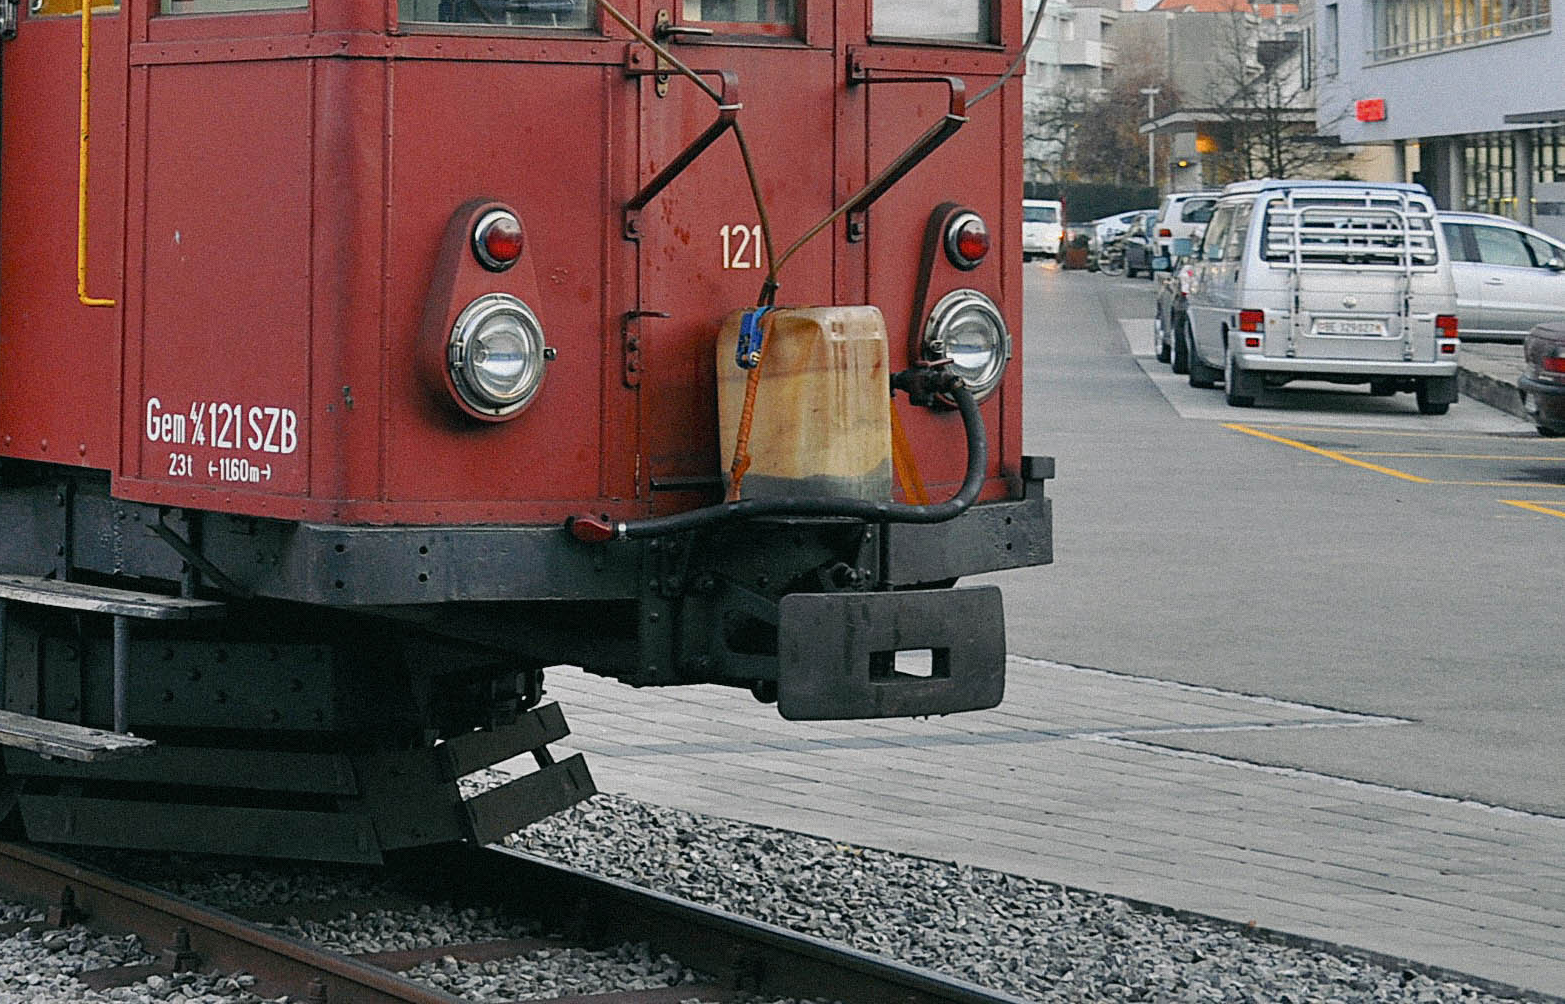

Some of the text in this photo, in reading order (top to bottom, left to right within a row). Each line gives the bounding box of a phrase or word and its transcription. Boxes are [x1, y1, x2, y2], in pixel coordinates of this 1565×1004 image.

[720, 225, 761, 268] 121
[146, 397, 185, 443] Gem
[208, 402, 242, 449] 121
[247, 406, 297, 454] SZB
